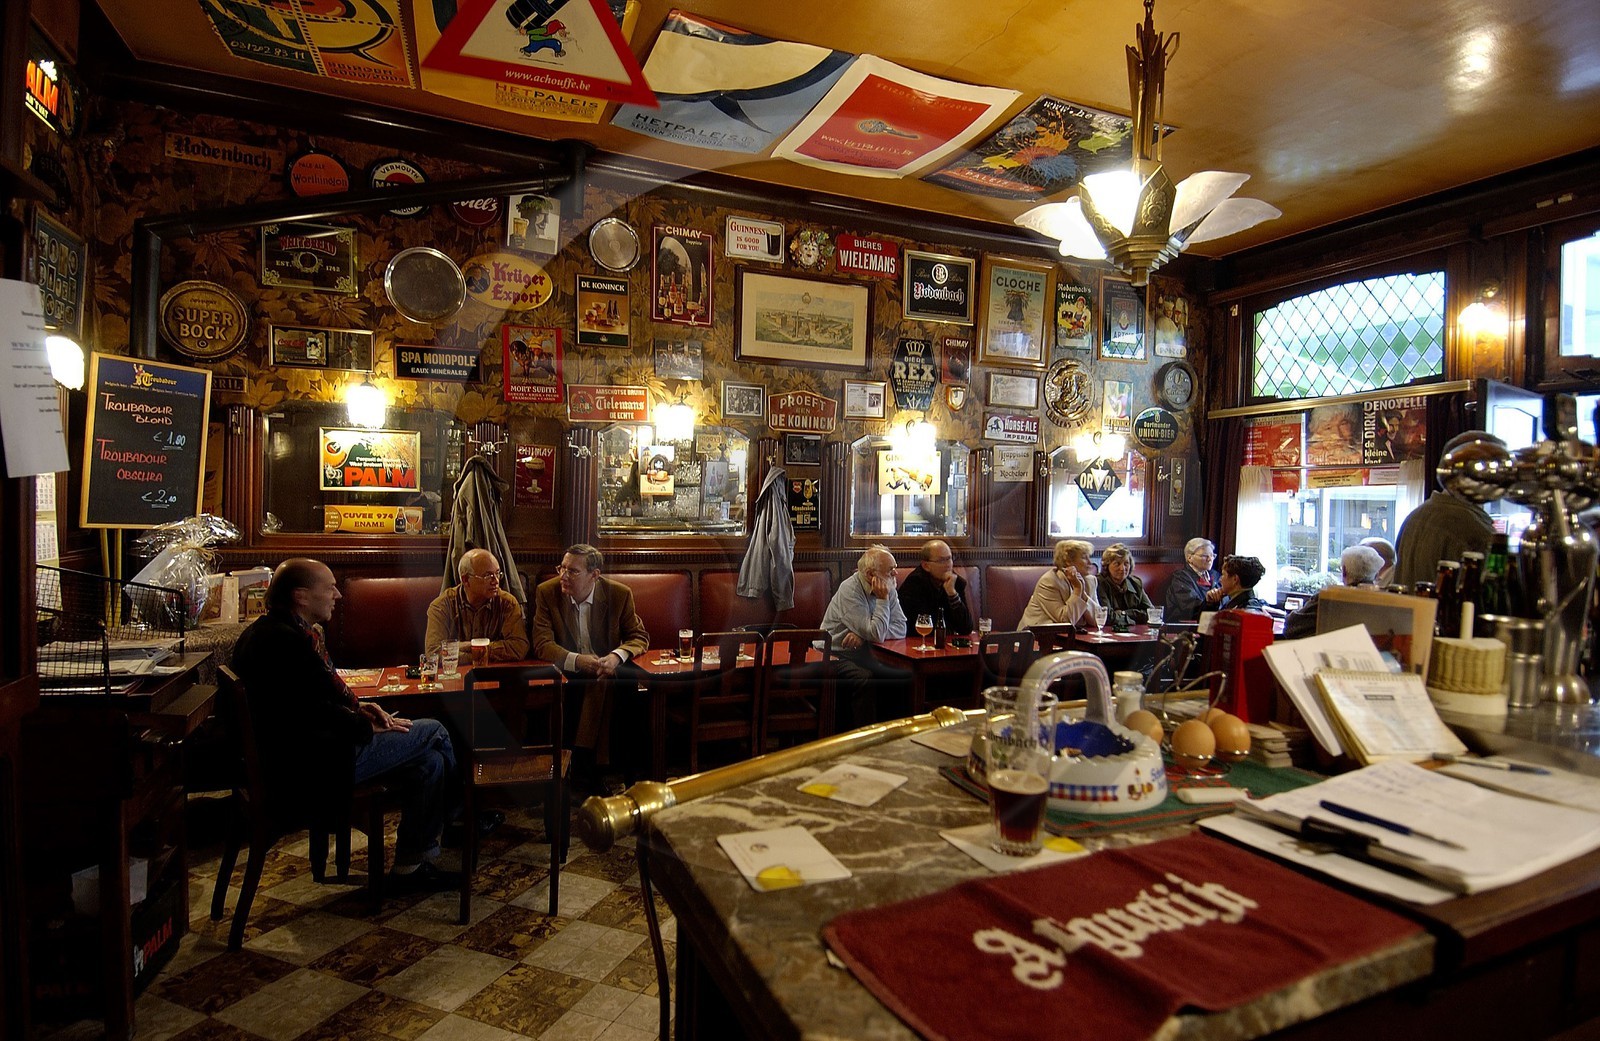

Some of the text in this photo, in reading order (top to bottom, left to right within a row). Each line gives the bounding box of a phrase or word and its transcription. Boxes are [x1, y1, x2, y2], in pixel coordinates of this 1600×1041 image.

[505, 70, 591, 91] www.achouffe.be
[495, 82, 599, 108] HETPALEIS
[635, 113, 737, 141] HETPALEIS
[174, 136, 271, 169] Rodenbach
[380, 165, 420, 179] VERMOUTH
[665, 225, 702, 239] CHIMAY
[730, 221, 766, 236] GUINNESS
[277, 236, 337, 256] WHITBREAD
[839, 249, 896, 274] WIELEMANS
[492, 260, 545, 289] Krüger
[592, 282, 625, 292] KONINCK
[996, 276, 1041, 292] CLOCHE
[492, 282, 542, 305] Export
[914, 281, 965, 305] Rodenbach
[174, 306, 233, 327] SUPER
[179, 322, 228, 341] BOCK
[945, 338, 969, 348] CHIMAY
[401, 351, 477, 367] SPA MONOPOLE
[430, 367, 468, 376] MINÉRALES
[893, 361, 935, 382] REX
[510, 385, 557, 394] MORT SUBITE
[595, 395, 645, 411] Tielemans
[780, 395, 826, 411] PROEFT
[132, 413, 173, 426] BLOND
[617, 412, 635, 420] ECHTE
[771, 414, 834, 430] DE KONINCK
[1004, 418, 1038, 432] HORSE-ALE
[1364, 411, 1376, 439] DIRK
[1004, 433, 1036, 441] IMPERIAL
[1364, 440, 1375, 448] de
[518, 445, 554, 457] CHIMAY
[1364, 449, 1388, 457] kleine
[116, 468, 163, 482] OBSCURA
[344, 466, 416, 488] PALM
[1079, 467, 1117, 492] ORVAL
